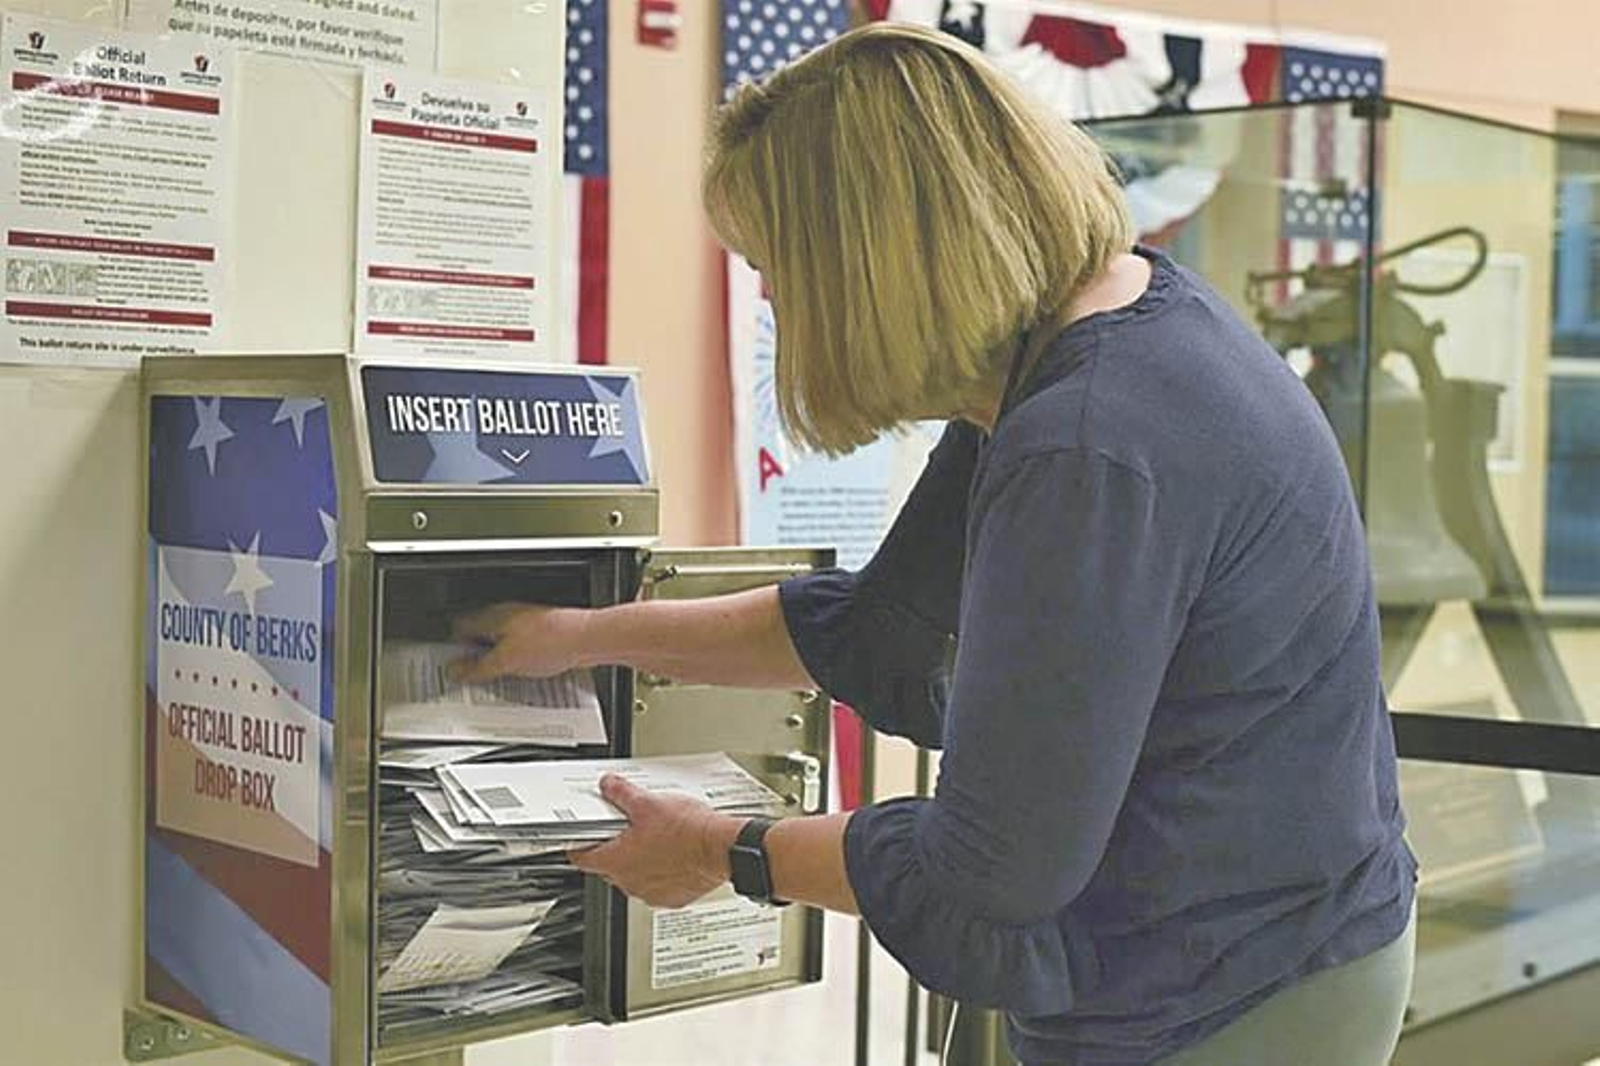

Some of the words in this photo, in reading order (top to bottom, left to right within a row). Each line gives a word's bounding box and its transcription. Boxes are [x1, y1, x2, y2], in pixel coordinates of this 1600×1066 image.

[357, 2, 379, 15] and
[213, 4, 228, 17] de
[296, 19, 317, 32] por
[319, 19, 350, 37] favor
[353, 29, 403, 46] verifique
[213, 25, 268, 44] papeleta
[271, 33, 297, 47] esté
[300, 36, 346, 55] firmada
[96, 46, 146, 66] Official
[119, 67, 167, 86] Return
[421, 92, 474, 111] Devuelva
[476, 102, 491, 114] su
[411, 107, 461, 126] Papeleta
[19, 336, 37, 348] This
[38, 338, 63, 349] ballot
[65, 341, 92, 351] return
[95, 342, 109, 352] site
[119, 343, 144, 353] under
[387, 395, 471, 432] INSERT
[478, 398, 561, 435] BALLOT
[566, 402, 624, 437] HERE
[161, 602, 226, 649] COUNTY
[229, 611, 252, 653] OF
[256, 614, 317, 664] BERKS
[168, 701, 237, 751] OFFICIAL
[241, 715, 306, 764] BALLOT
[195, 757, 238, 803] DROP
[240, 767, 276, 813] BOX
